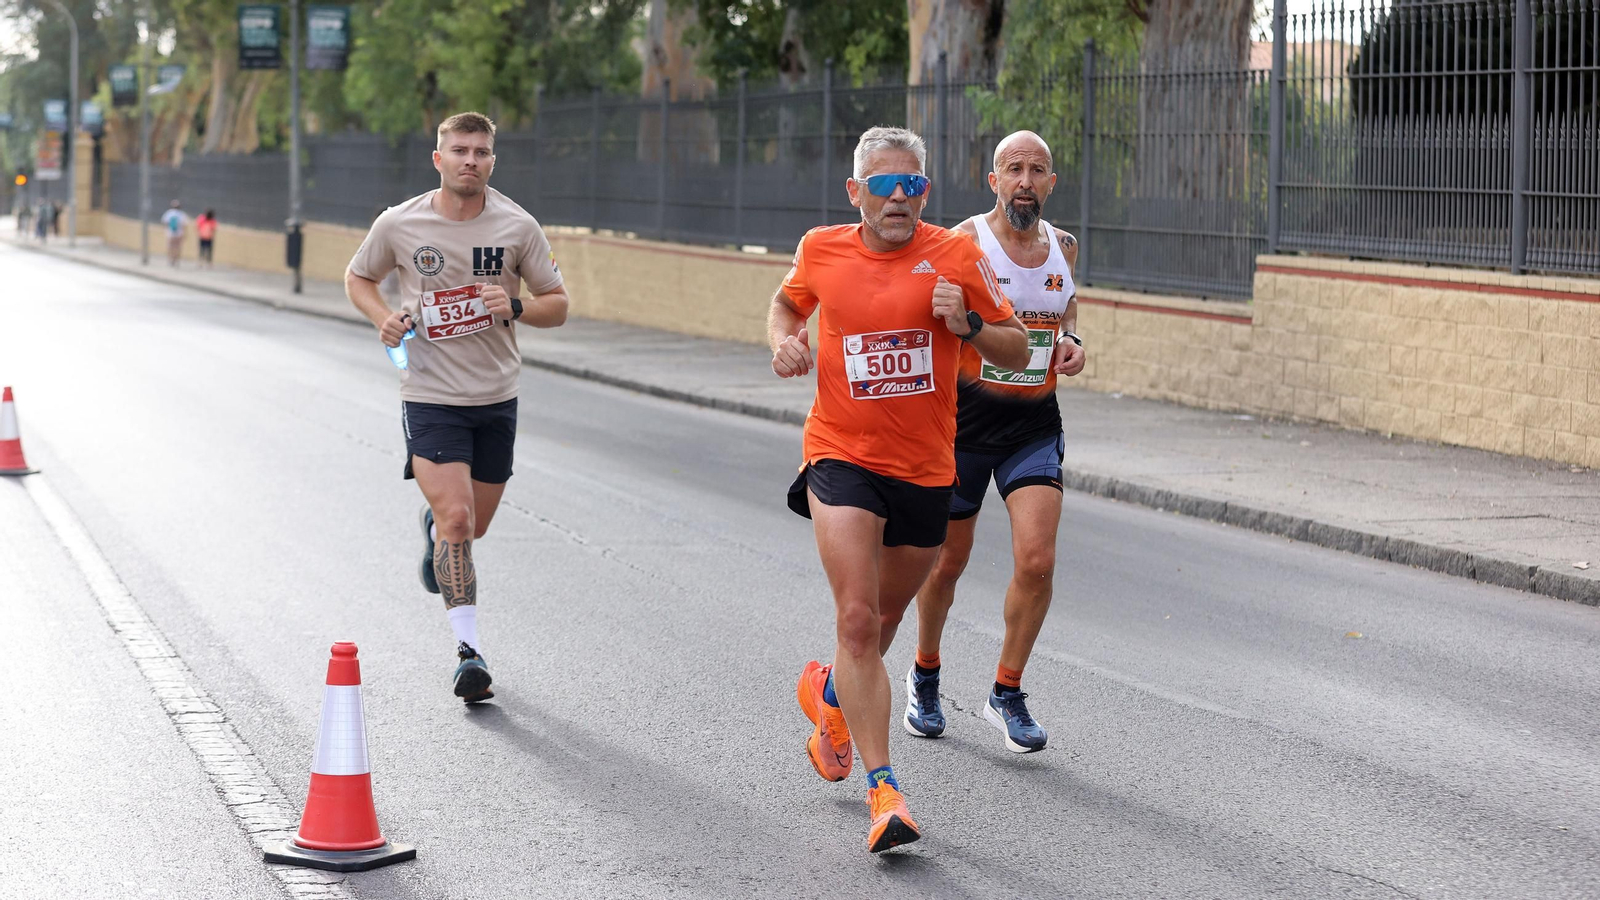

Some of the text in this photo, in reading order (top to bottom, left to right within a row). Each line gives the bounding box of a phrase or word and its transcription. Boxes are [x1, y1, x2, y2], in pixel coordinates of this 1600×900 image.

[473, 247, 504, 269] IX
[439, 302, 475, 322] 534
[1015, 311, 1062, 319] UBYSAN
[867, 353, 912, 377] 500
